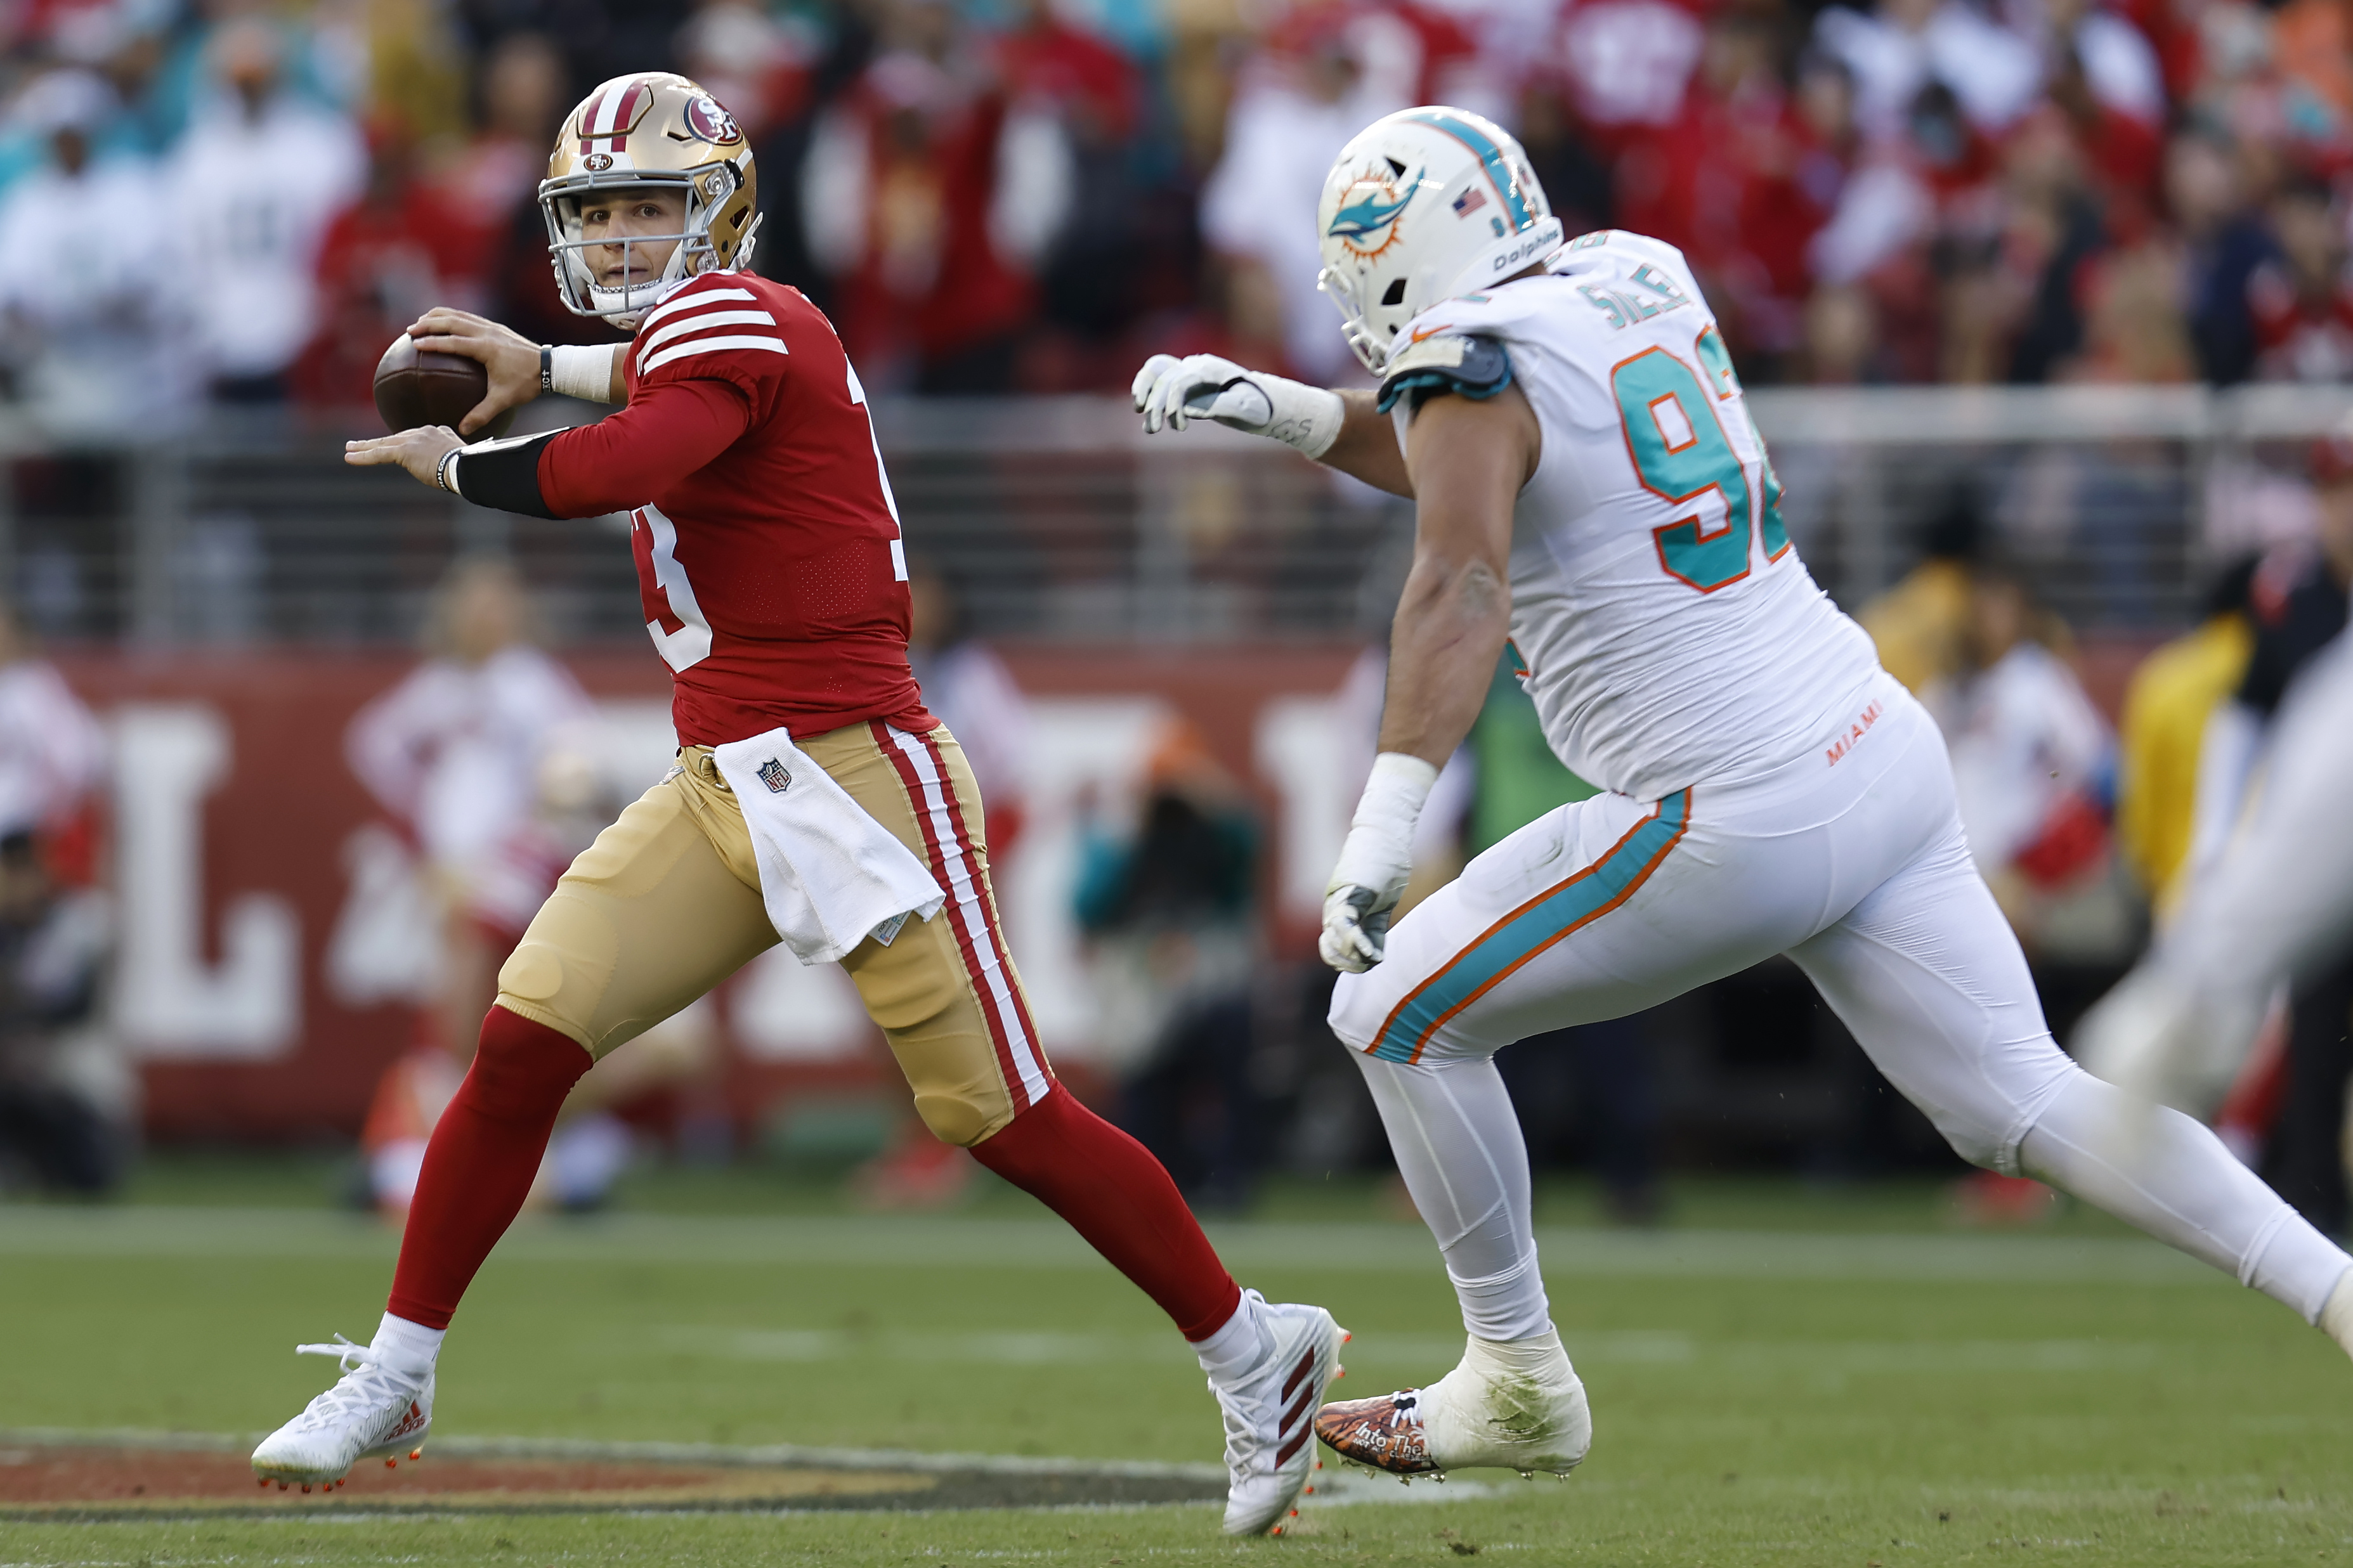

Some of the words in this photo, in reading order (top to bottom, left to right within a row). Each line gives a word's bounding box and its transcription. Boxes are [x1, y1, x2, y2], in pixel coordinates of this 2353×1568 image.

[1493, 229, 1559, 271] Dolphins
[1825, 698, 1884, 768] MIAMI
[766, 770, 790, 791] NFL
[382, 1415, 426, 1442] adidas
[1355, 1421, 1387, 1447] Into
[1393, 1434, 1422, 1456] The
